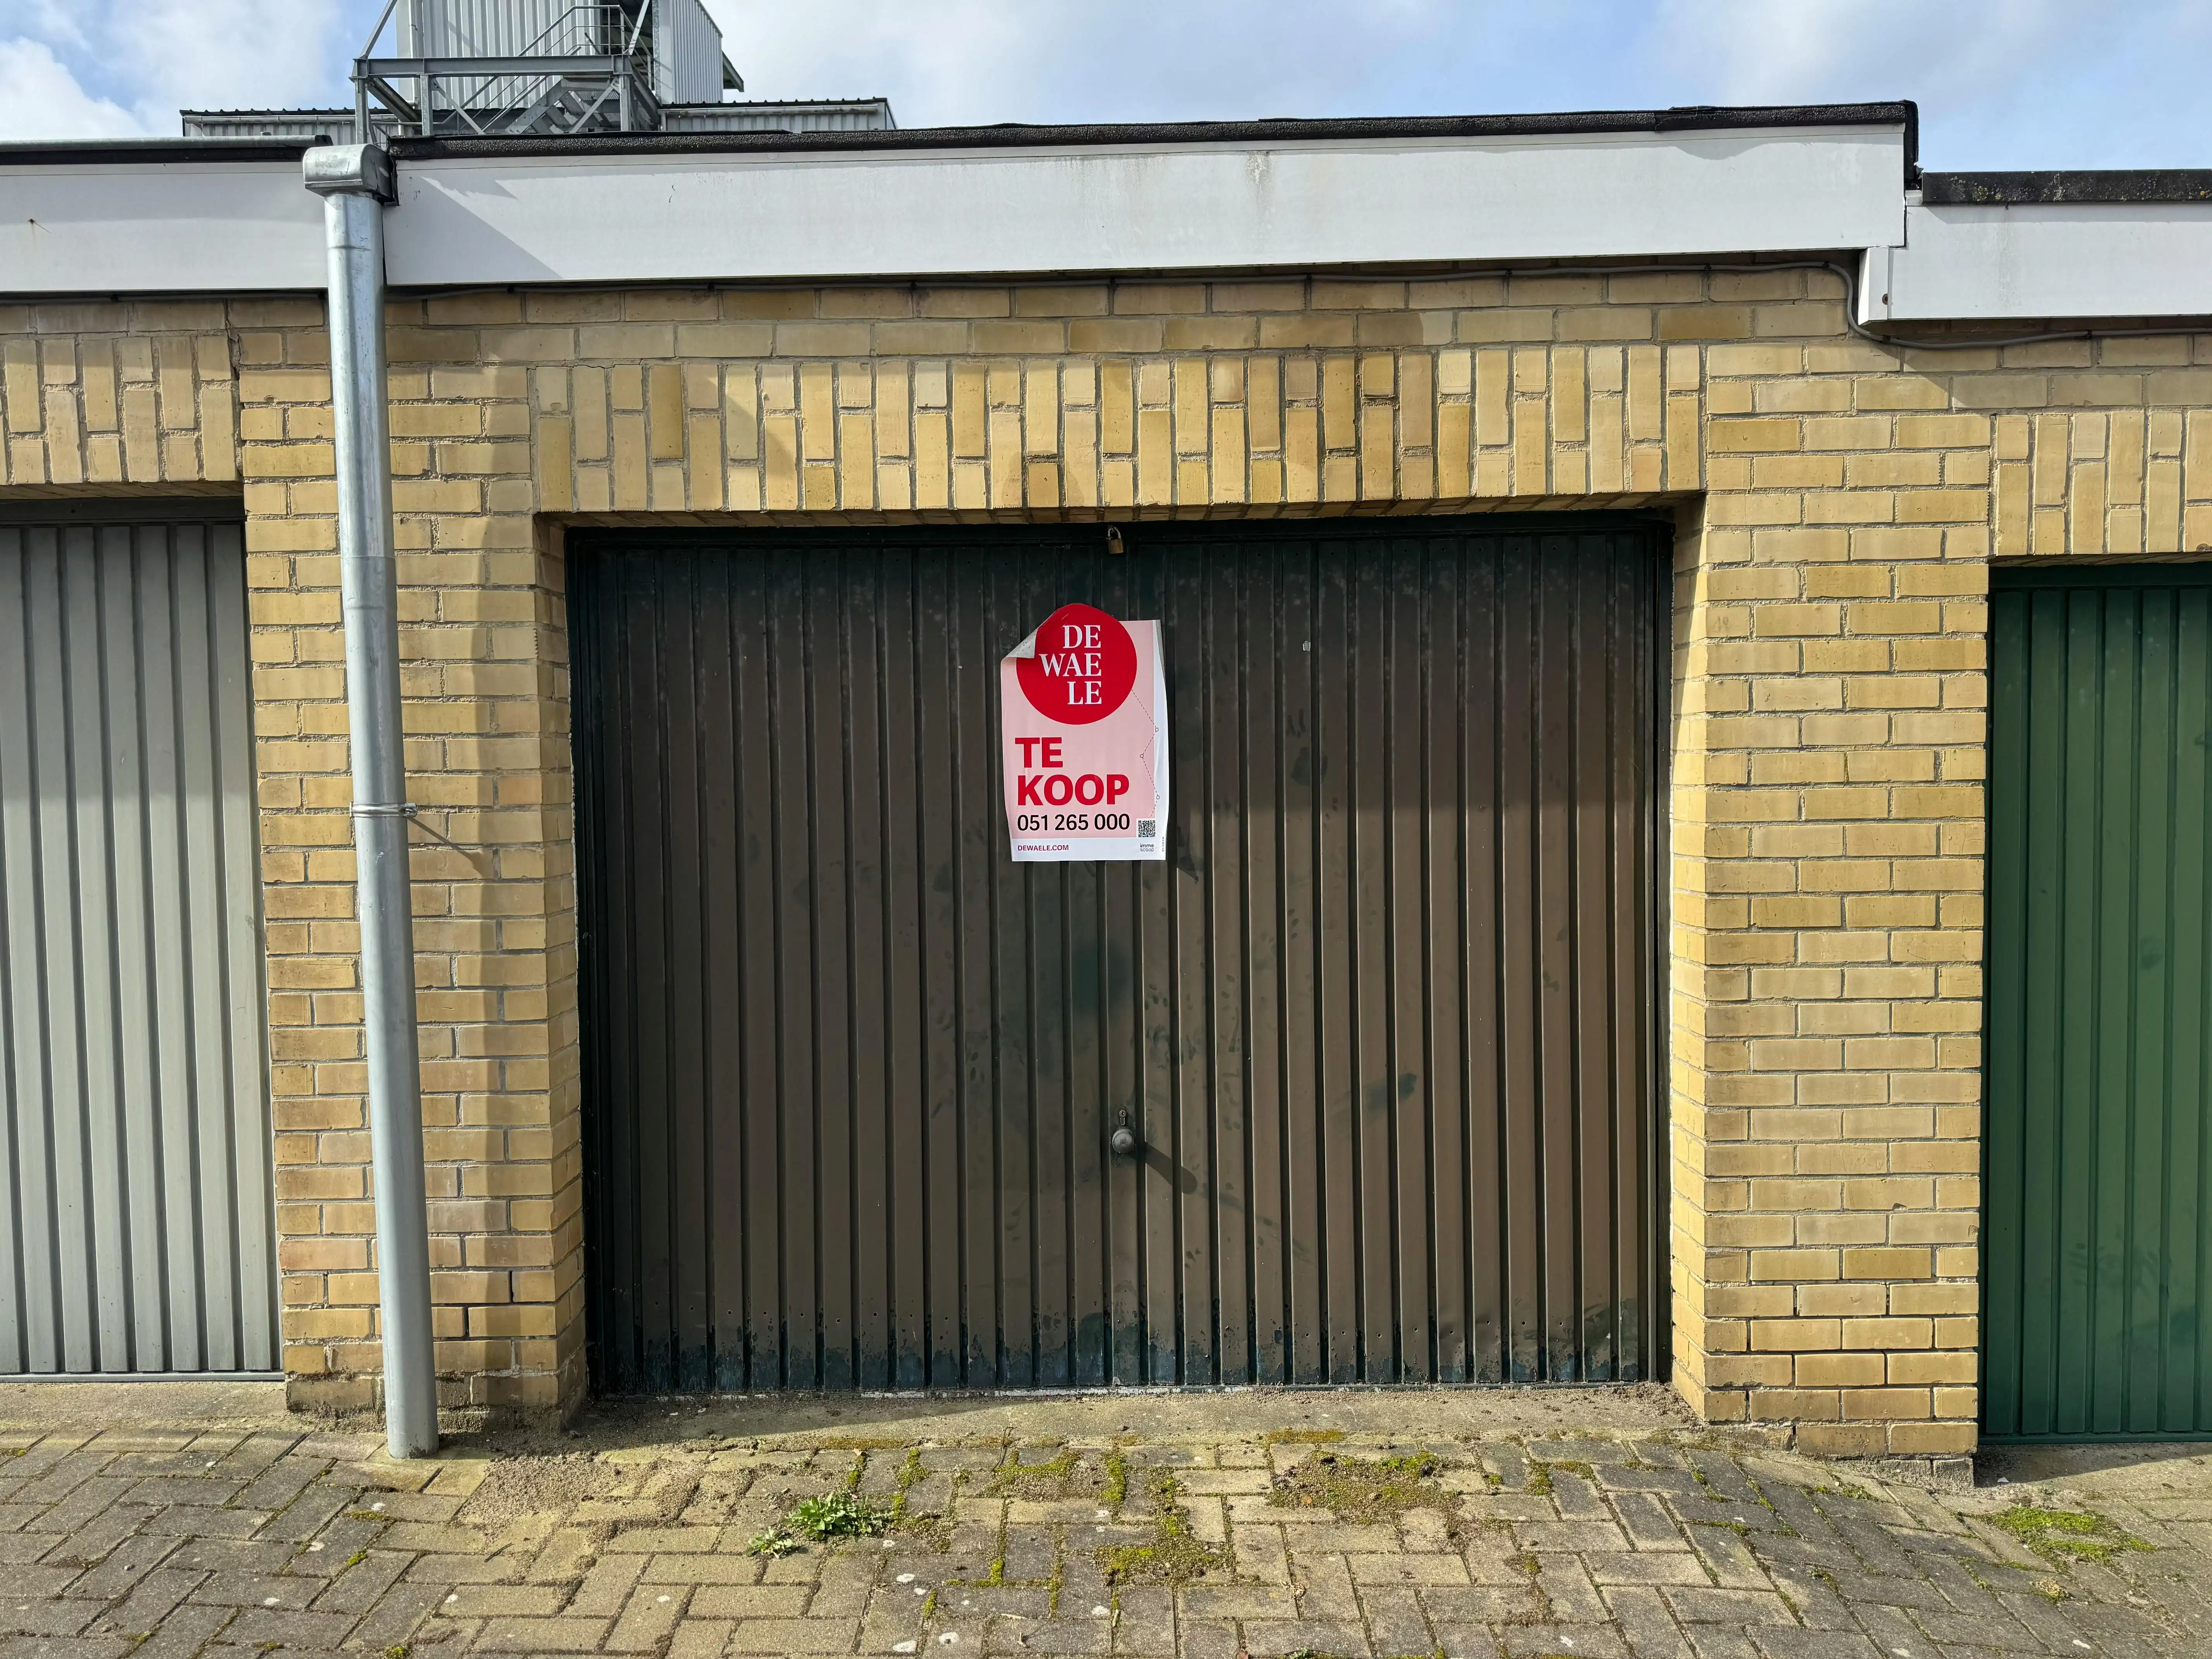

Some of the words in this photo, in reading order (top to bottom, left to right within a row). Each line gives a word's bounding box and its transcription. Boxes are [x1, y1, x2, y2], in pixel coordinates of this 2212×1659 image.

[1062, 625, 1101, 649] DE
[1039, 653, 1101, 677] WAE
[1067, 681, 1102, 705] LE
[1015, 737, 1063, 768] TE
[1017, 774, 1129, 806] KOOP
[1017, 814, 1048, 831] 051
[1054, 814, 1089, 831] 265
[1094, 813, 1130, 830] 000
